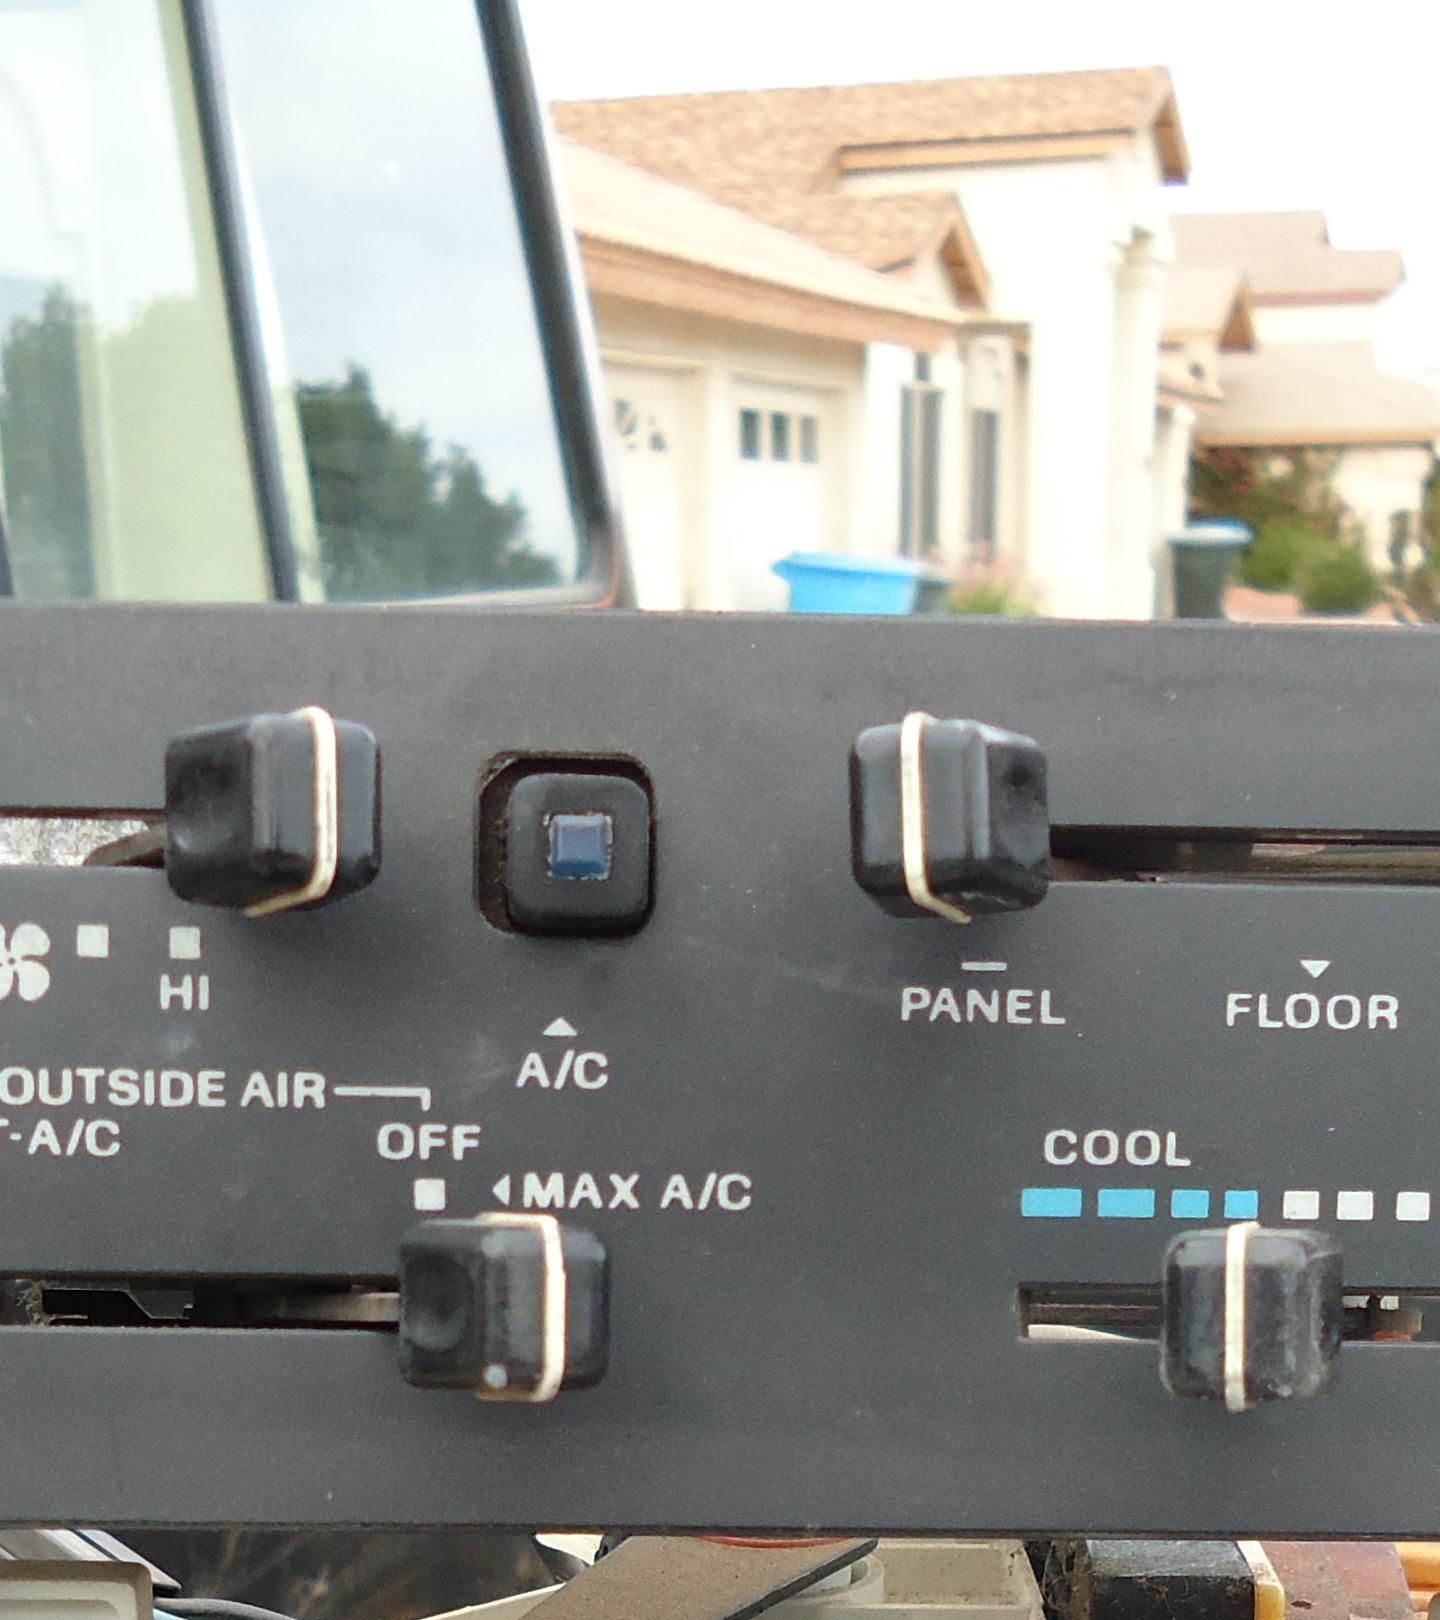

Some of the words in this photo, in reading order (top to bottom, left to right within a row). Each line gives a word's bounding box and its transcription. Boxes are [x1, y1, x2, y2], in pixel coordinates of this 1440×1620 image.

[160, 975, 209, 1010] HI
[902, 987, 1066, 1024] PANEL
[1227, 993, 1398, 1029] FLOOR
[517, 1050, 608, 1089] A/C
[240, 1072, 325, 1108] AIR
[378, 1123, 480, 1160] OFF
[1045, 1130, 1191, 1166] COOL
[523, 1173, 639, 1208] MAX
[661, 1173, 751, 1210] A/C
